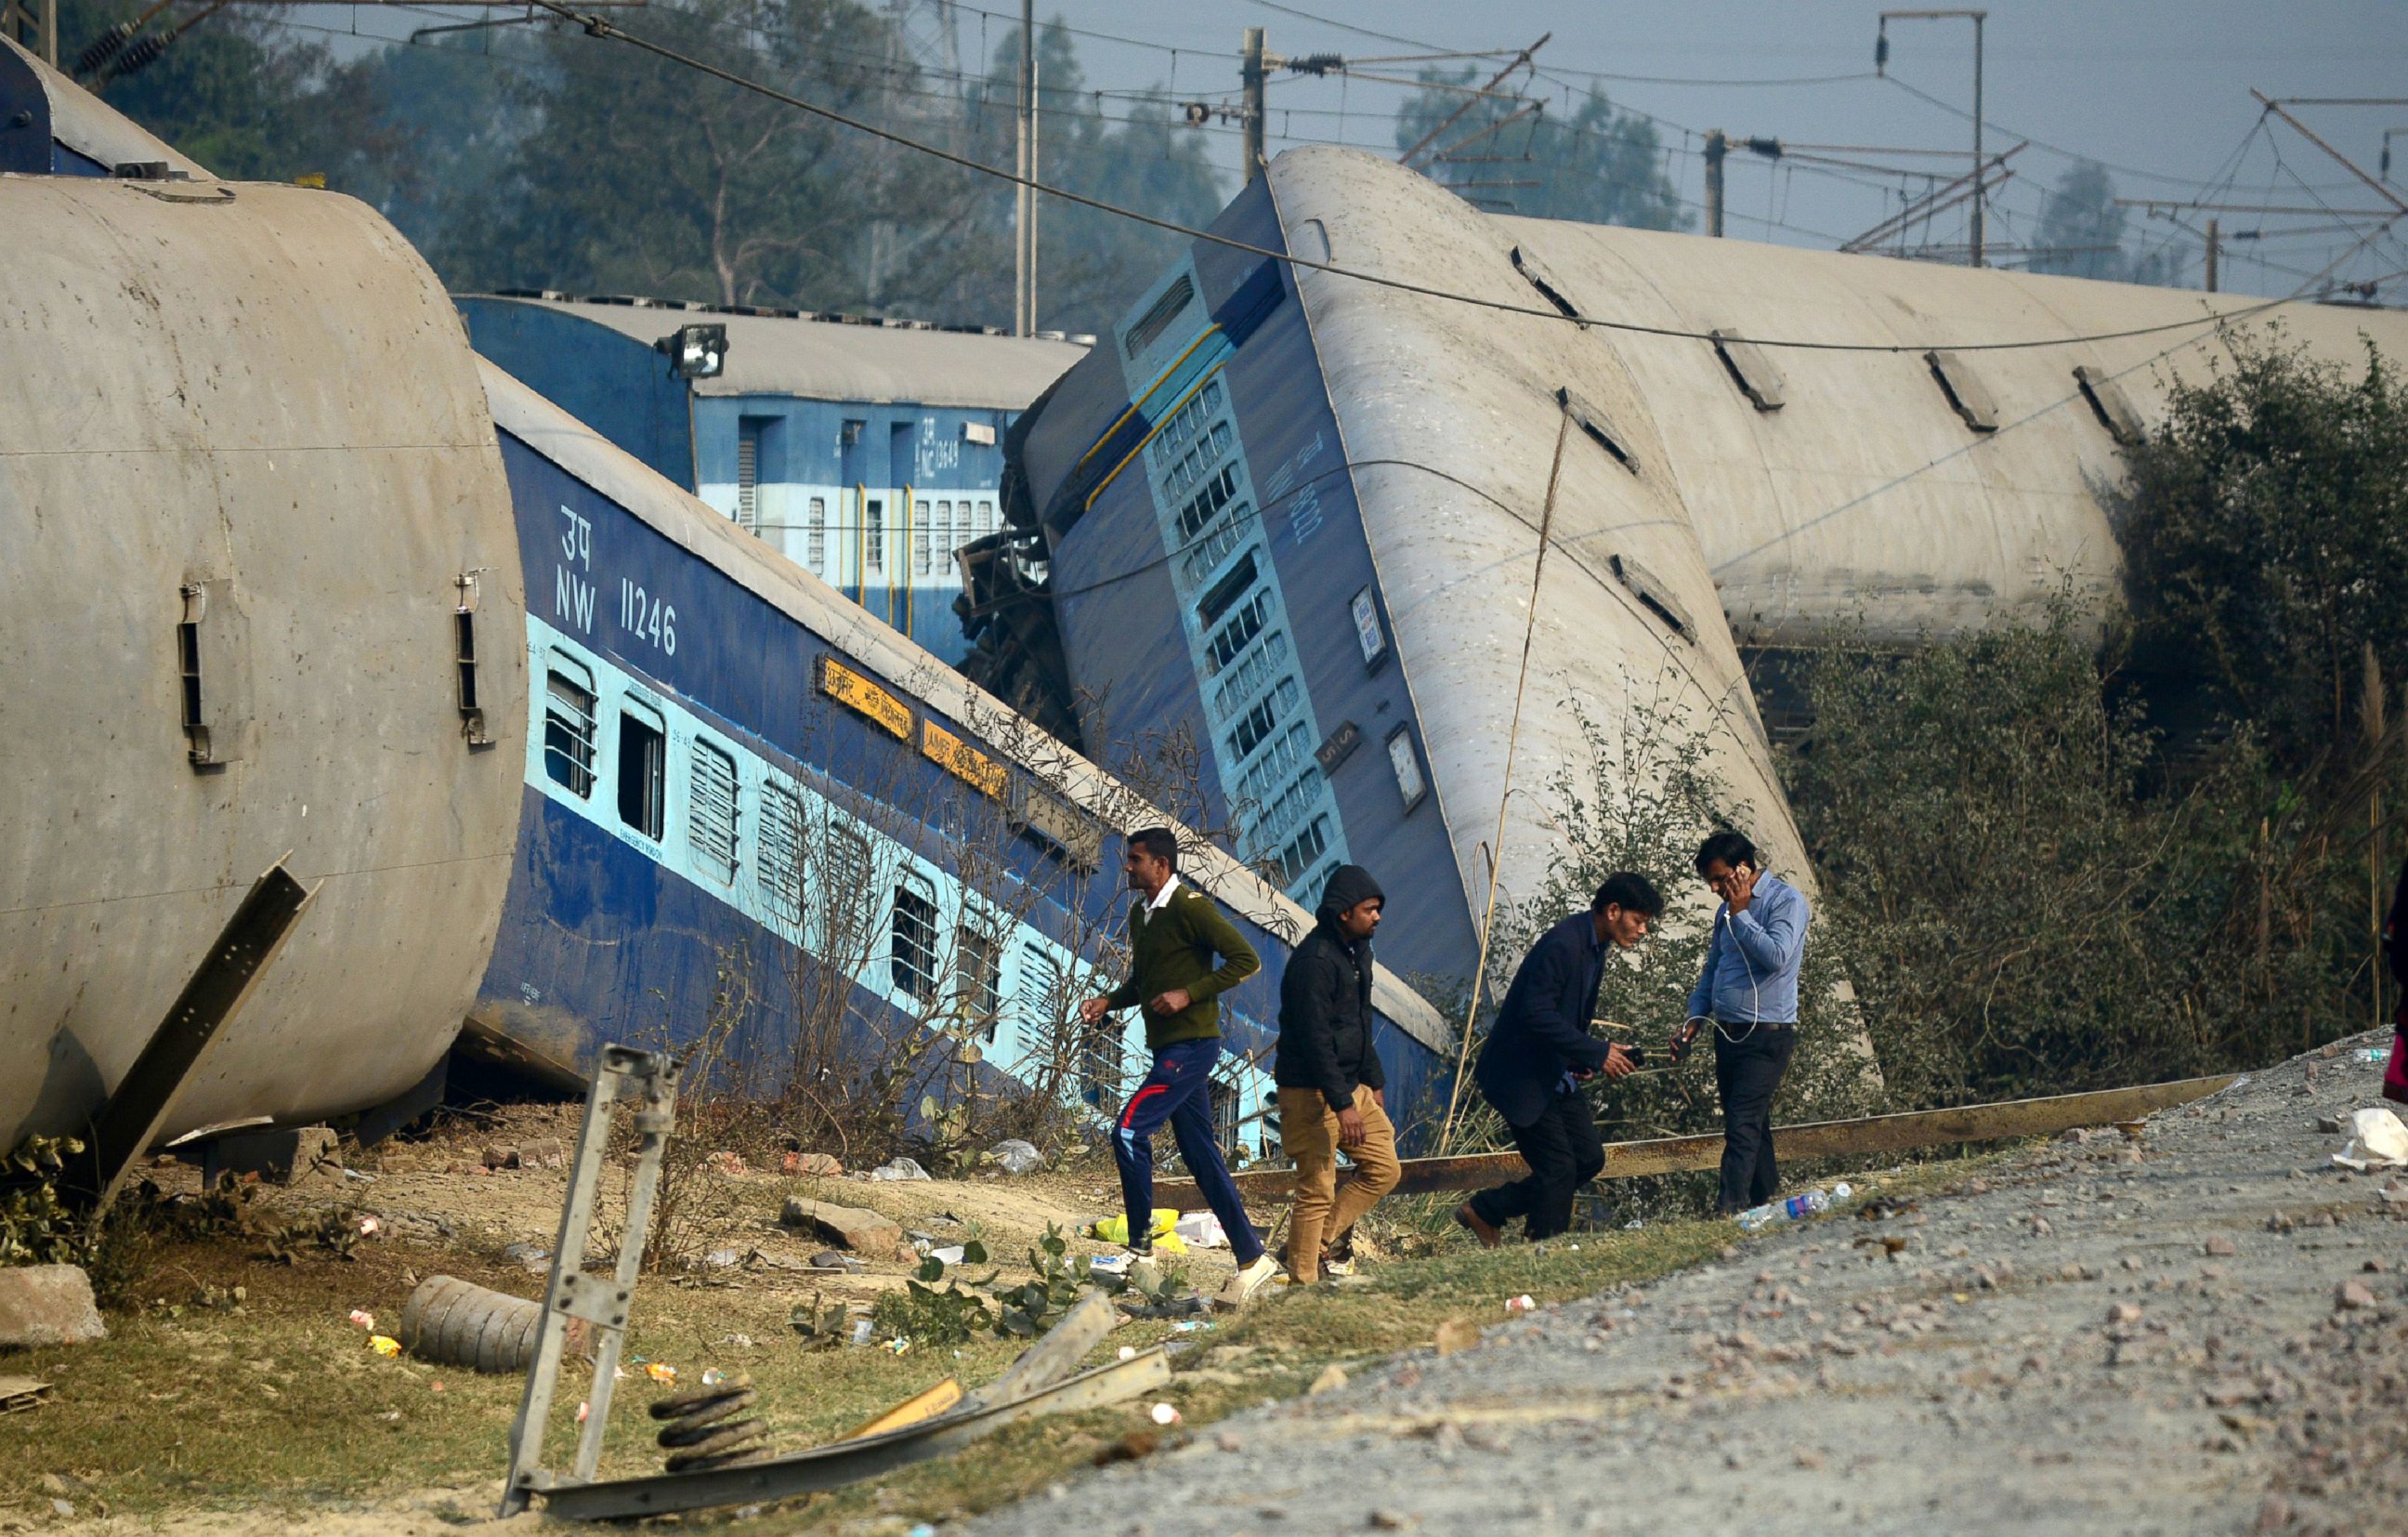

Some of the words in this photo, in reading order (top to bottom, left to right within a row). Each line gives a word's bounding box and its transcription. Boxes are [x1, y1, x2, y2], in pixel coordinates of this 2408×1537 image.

[560, 504, 592, 572] उप
[556, 563, 596, 635] NW
[621, 577, 676, 656] 11246
[1340, 729, 1354, 744] S
